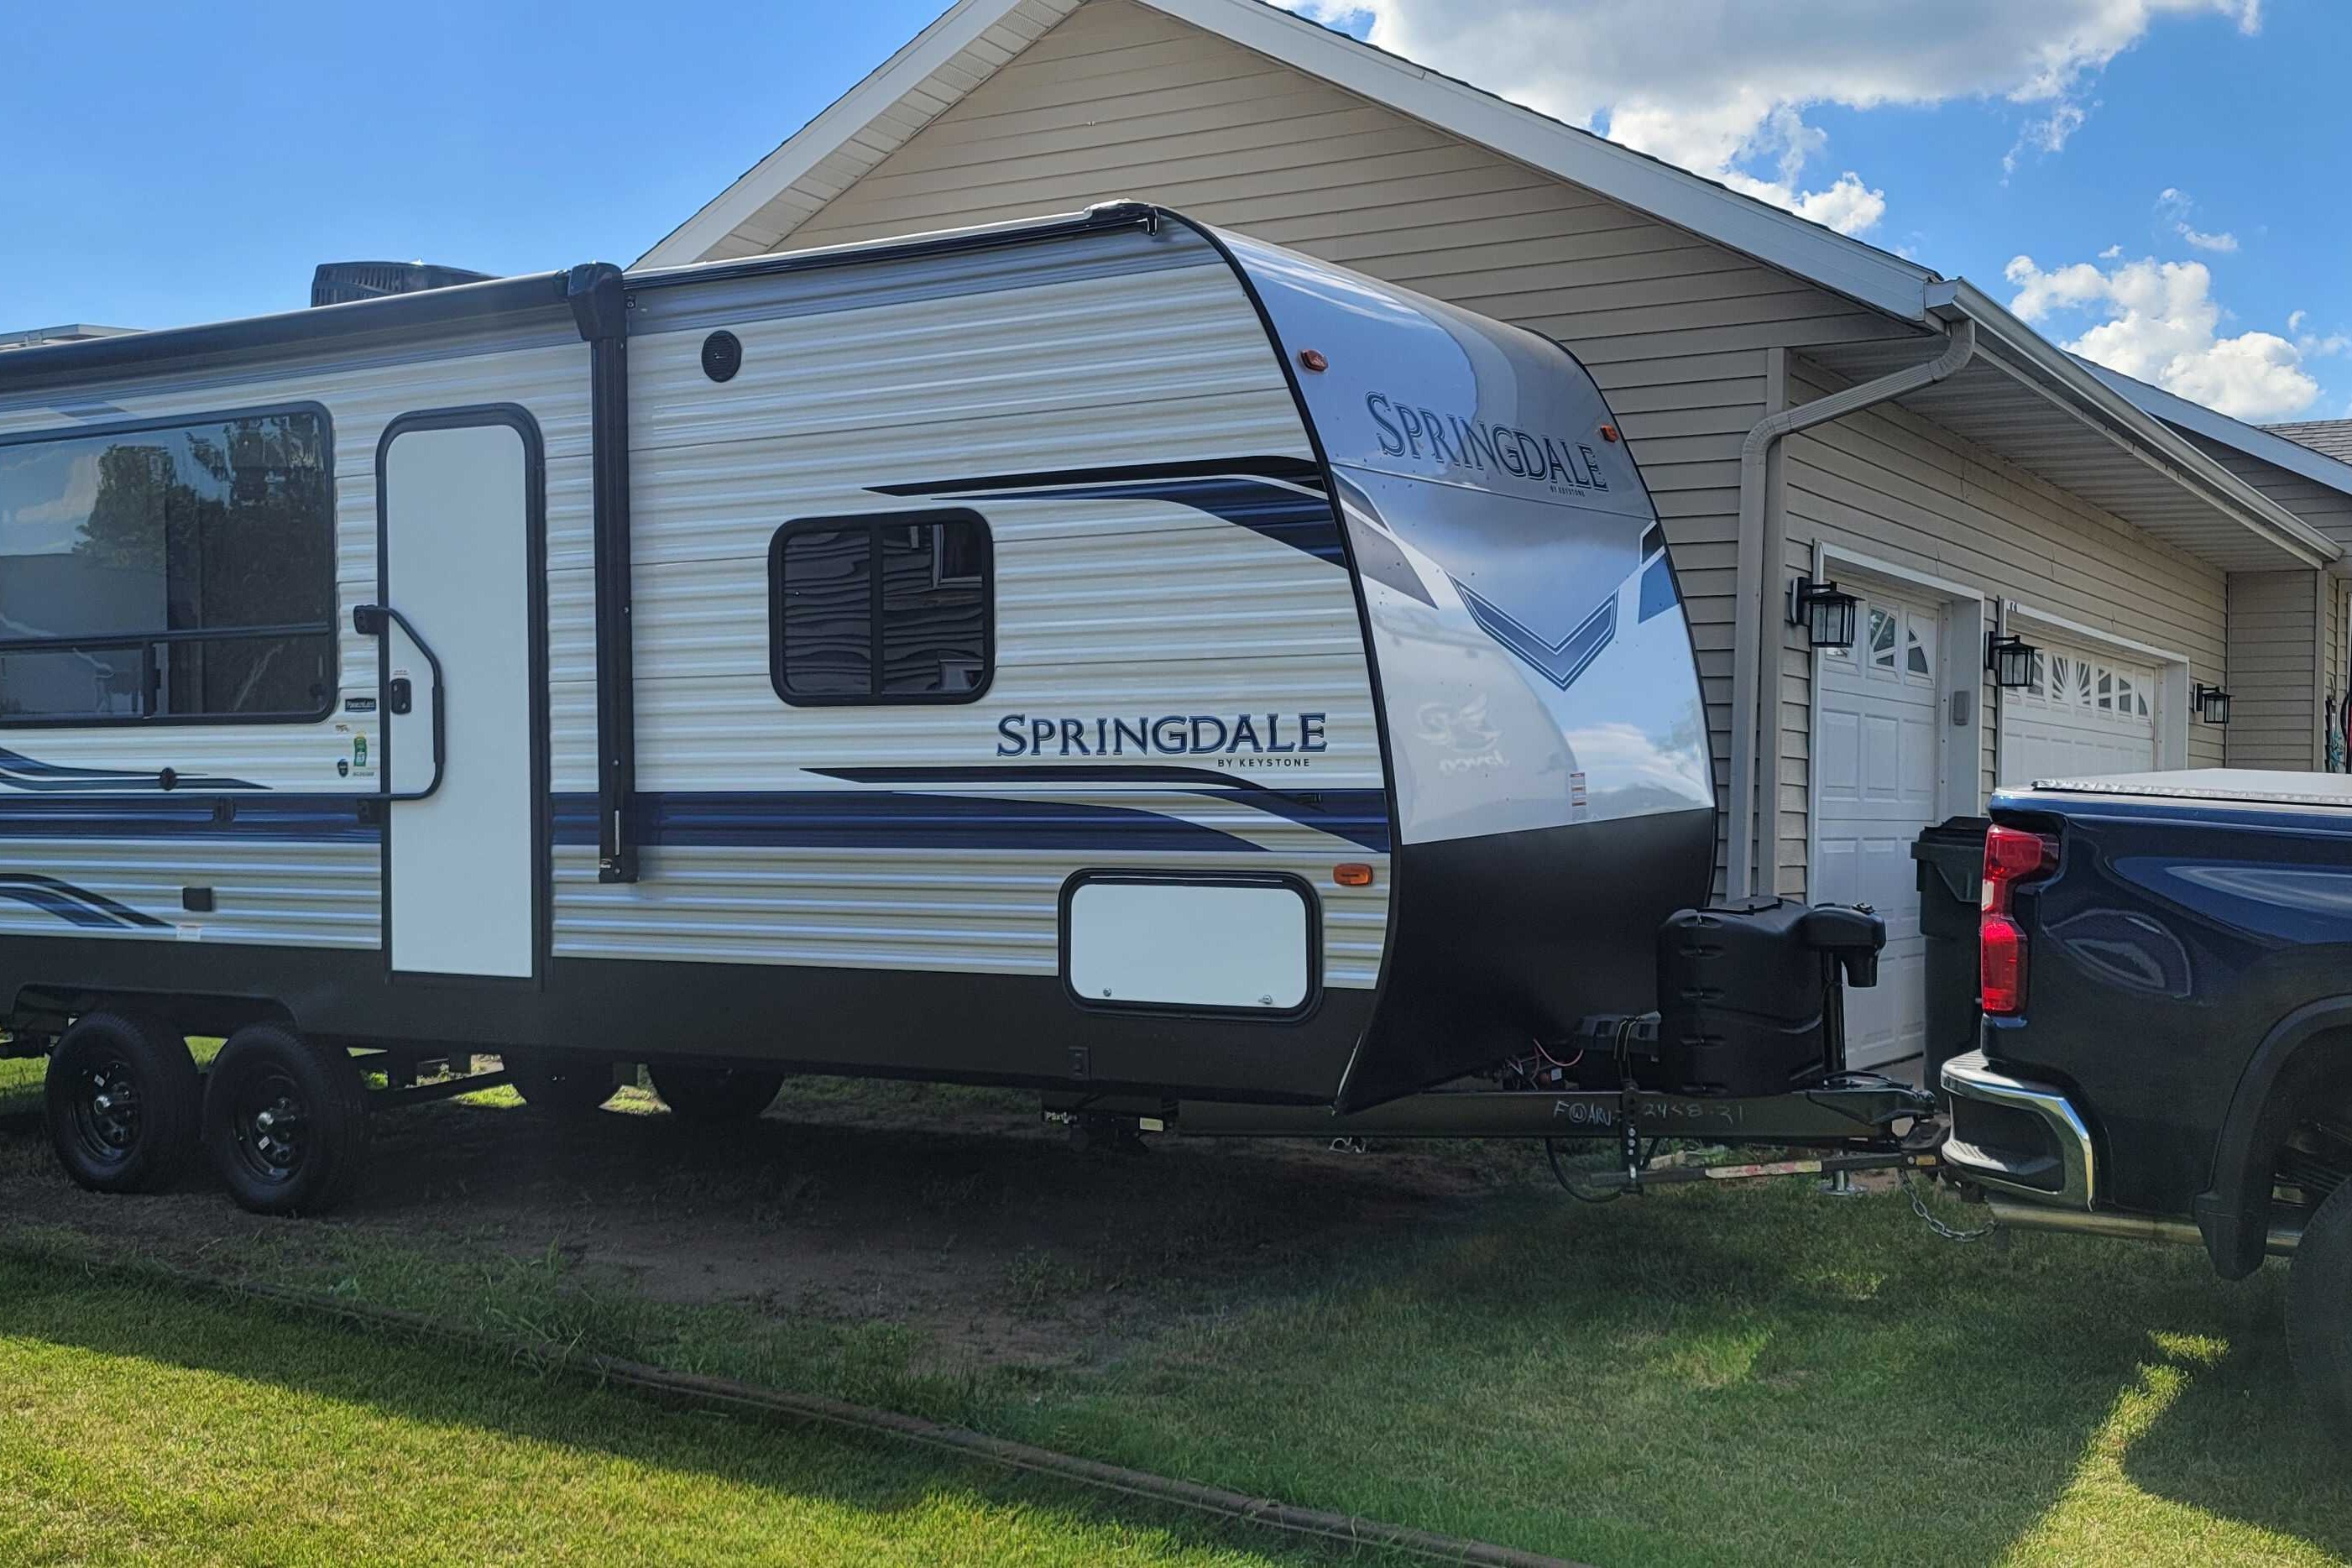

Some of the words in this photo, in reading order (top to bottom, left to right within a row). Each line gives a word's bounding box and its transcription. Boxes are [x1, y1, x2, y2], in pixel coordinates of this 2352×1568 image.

[1365, 390, 1609, 493] SPRINGDALE
[996, 713, 1328, 756] SPRINGDALE
[1217, 758, 1232, 767] BY
[1239, 758, 1310, 767] KEYSTONE
